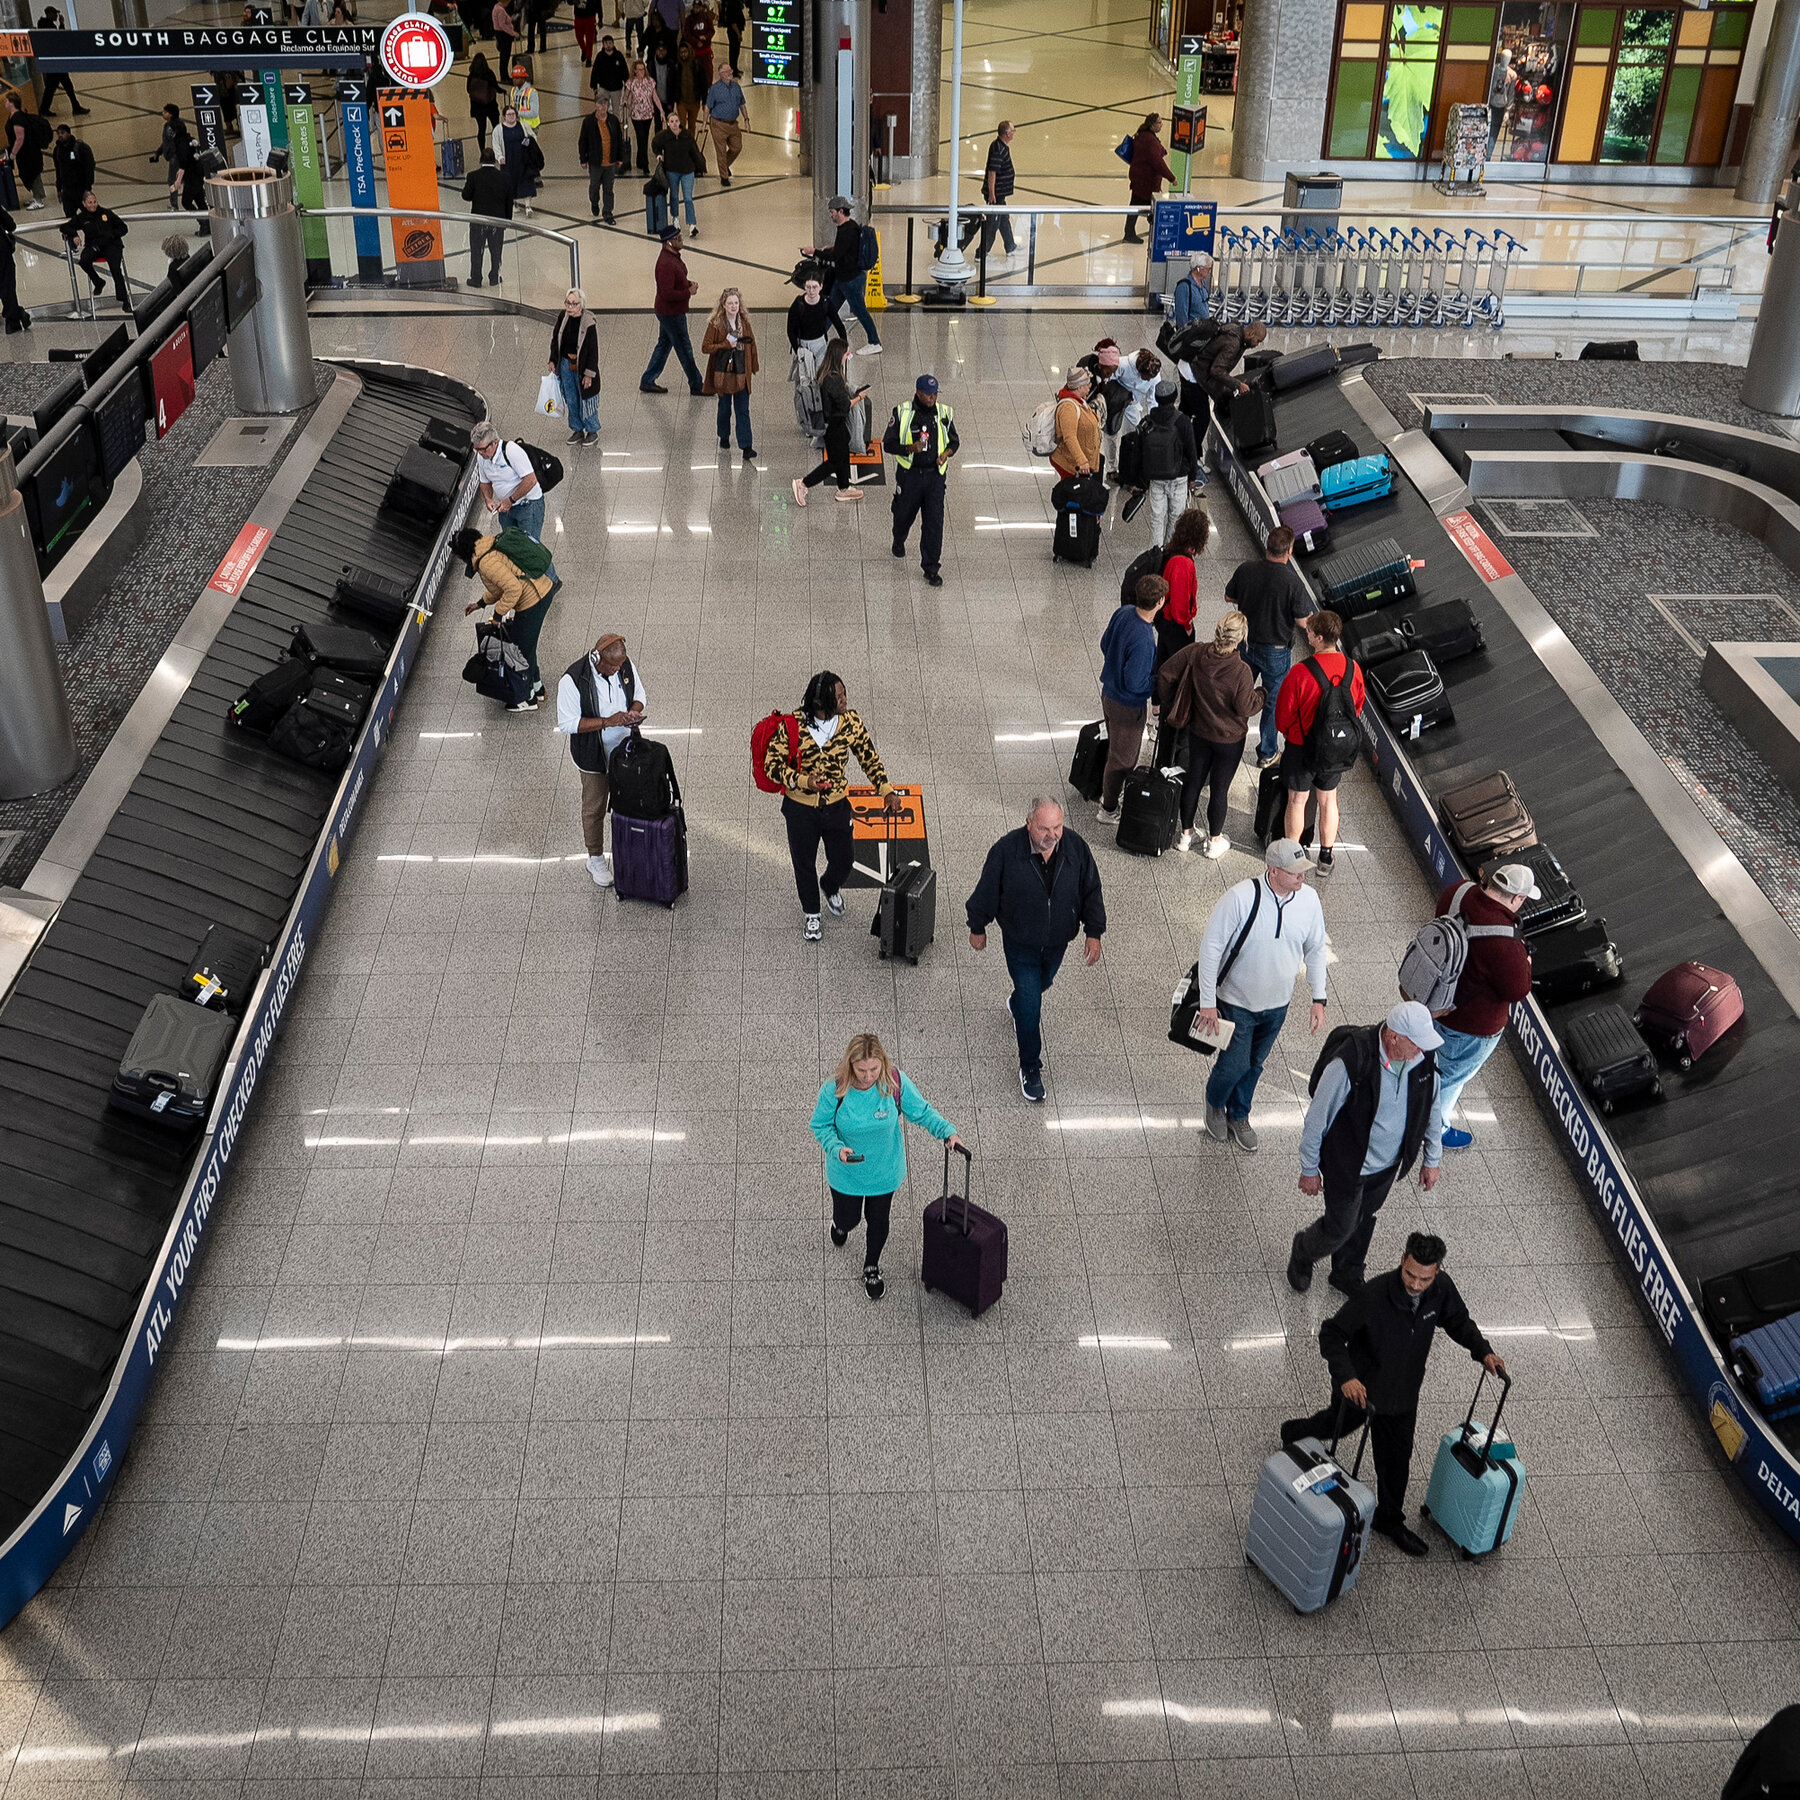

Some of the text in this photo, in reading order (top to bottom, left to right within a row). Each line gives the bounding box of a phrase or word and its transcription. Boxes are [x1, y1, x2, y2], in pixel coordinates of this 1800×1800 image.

[777, 6, 784, 17] 7
[94, 29, 376, 46] SOUTH BAGGAGE CLAIM
[327, 44, 361, 54] Equipaje
[362, 44, 376, 52] Sur
[777, 35, 784, 46] 3
[386, 21, 430, 84] SOUTH BAGGAGE CLAIM
[777, 64, 784, 75] 7
[1184, 74, 1193, 99] Gates
[207, 127, 217, 150] KCM
[300, 126, 311, 169] All Gates
[354, 125, 367, 195] TSA PreCheck
[406, 235, 432, 254] DETOUR
[158, 398, 167, 429] 4
[1513, 1001, 1543, 1066] FIRST
[1540, 1054, 1590, 1158] CHECKED
[1586, 1144, 1616, 1210] BAG
[1611, 1193, 1648, 1273] FLIES
[146, 1302, 171, 1366] ATL,
[165, 1227, 198, 1301] YOUR
[193, 1152, 223, 1232] FIRST
[218, 1058, 257, 1164] CHECKED
[254, 1012, 273, 1069] BAG
[269, 964, 289, 1029] FLIES
